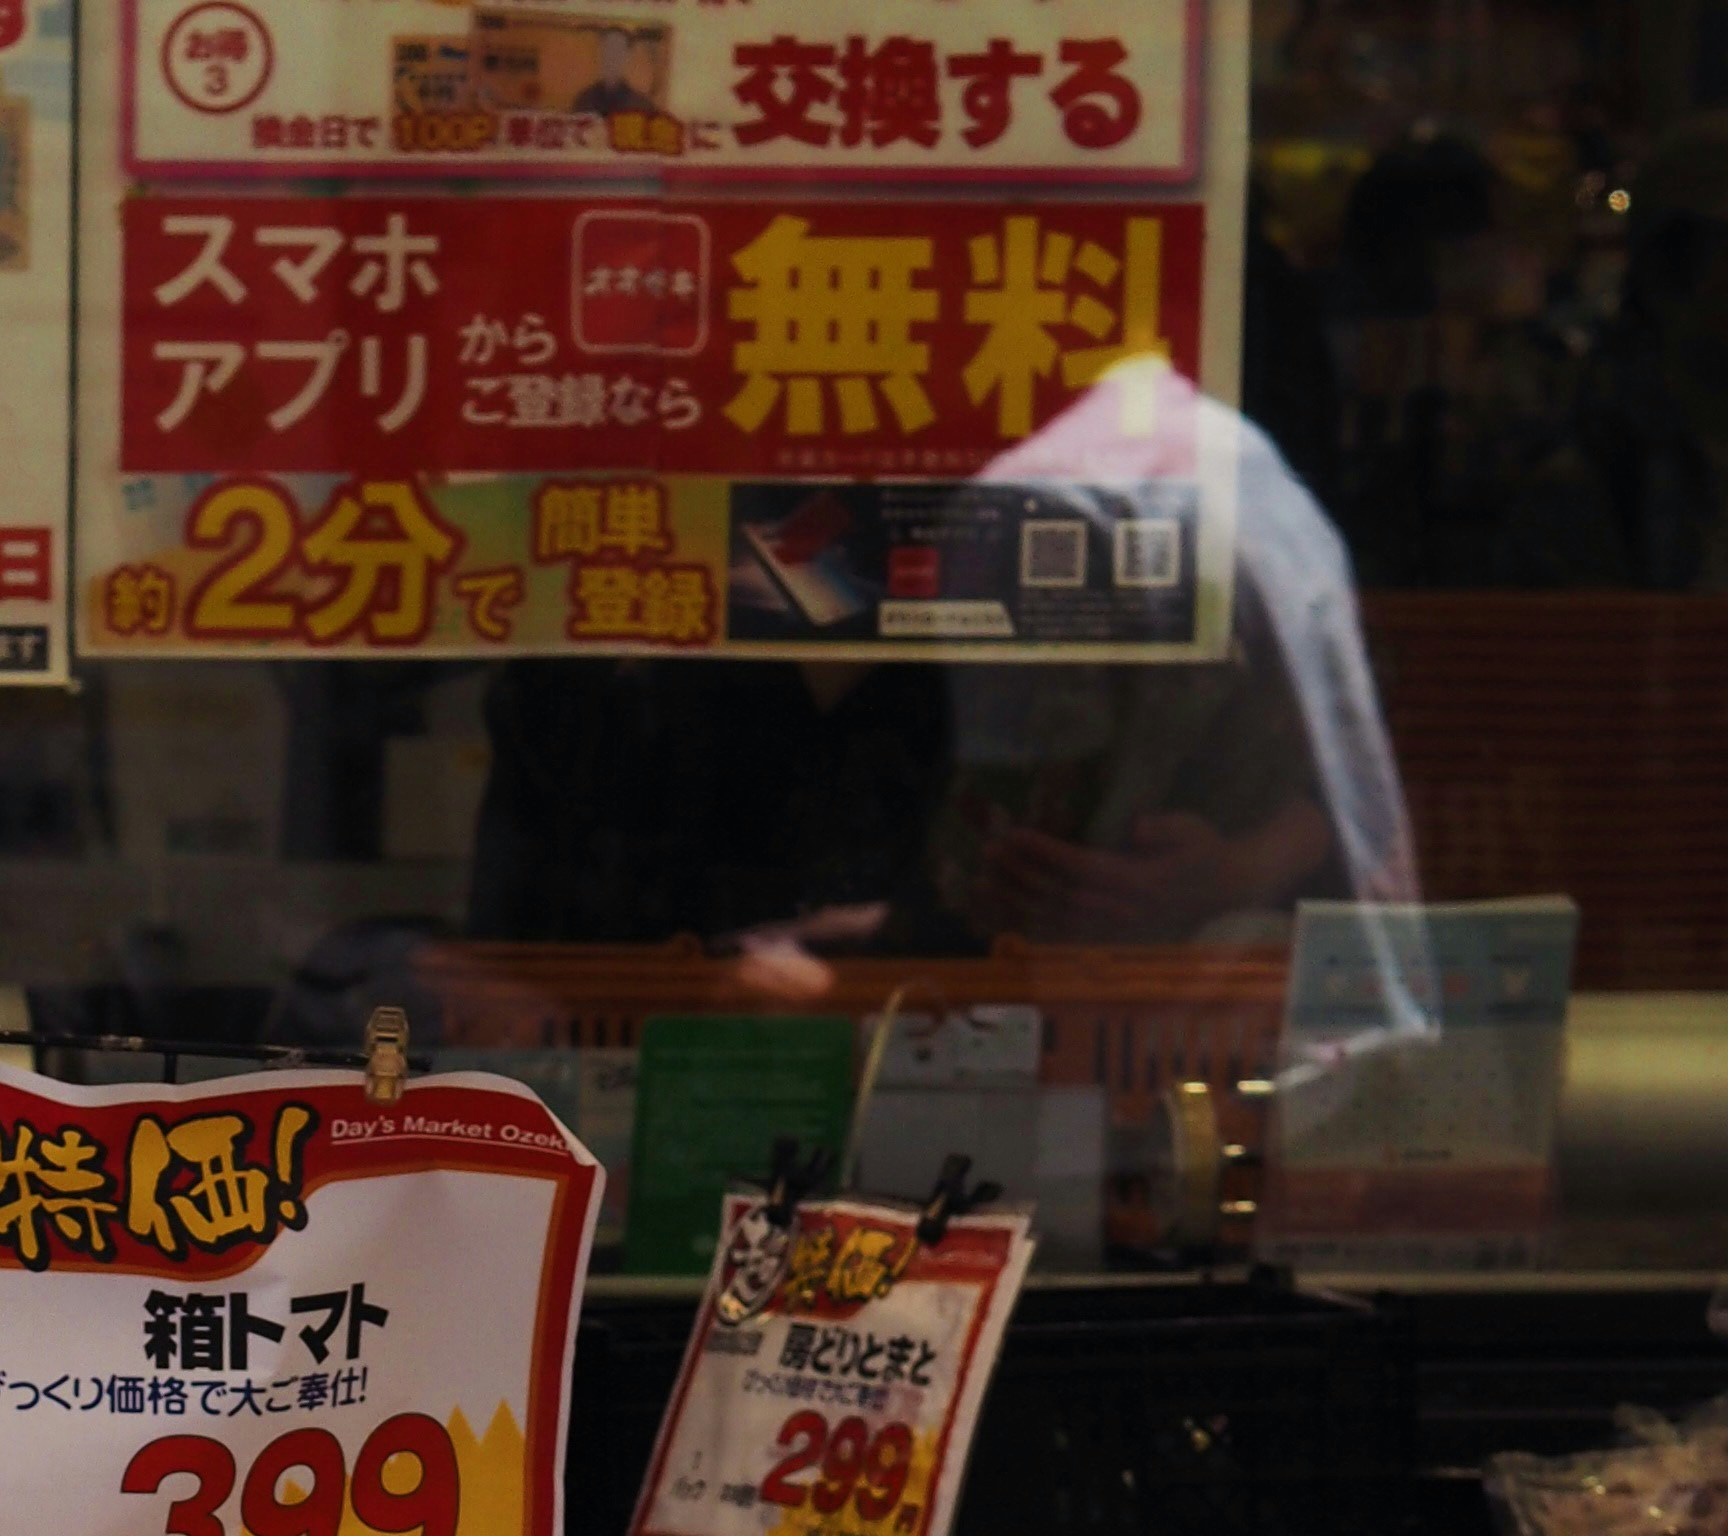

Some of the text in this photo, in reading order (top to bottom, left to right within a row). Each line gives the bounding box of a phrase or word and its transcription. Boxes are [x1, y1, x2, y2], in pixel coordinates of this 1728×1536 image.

[732, 35, 1143, 150] 交換する
[154, 213, 440, 312] スマホ
[459, 314, 559, 365] から
[724, 213, 1170, 440] 無料
[154, 328, 429, 433] アプリ
[461, 374, 702, 430] ご登録なら
[538, 485, 668, 558] 簡単
[573, 567, 712, 641] 登録
[330, 1116, 399, 1140] Day's
[402, 1116, 492, 1141] Market
[144, 1282, 389, 1371] 箱トマト
